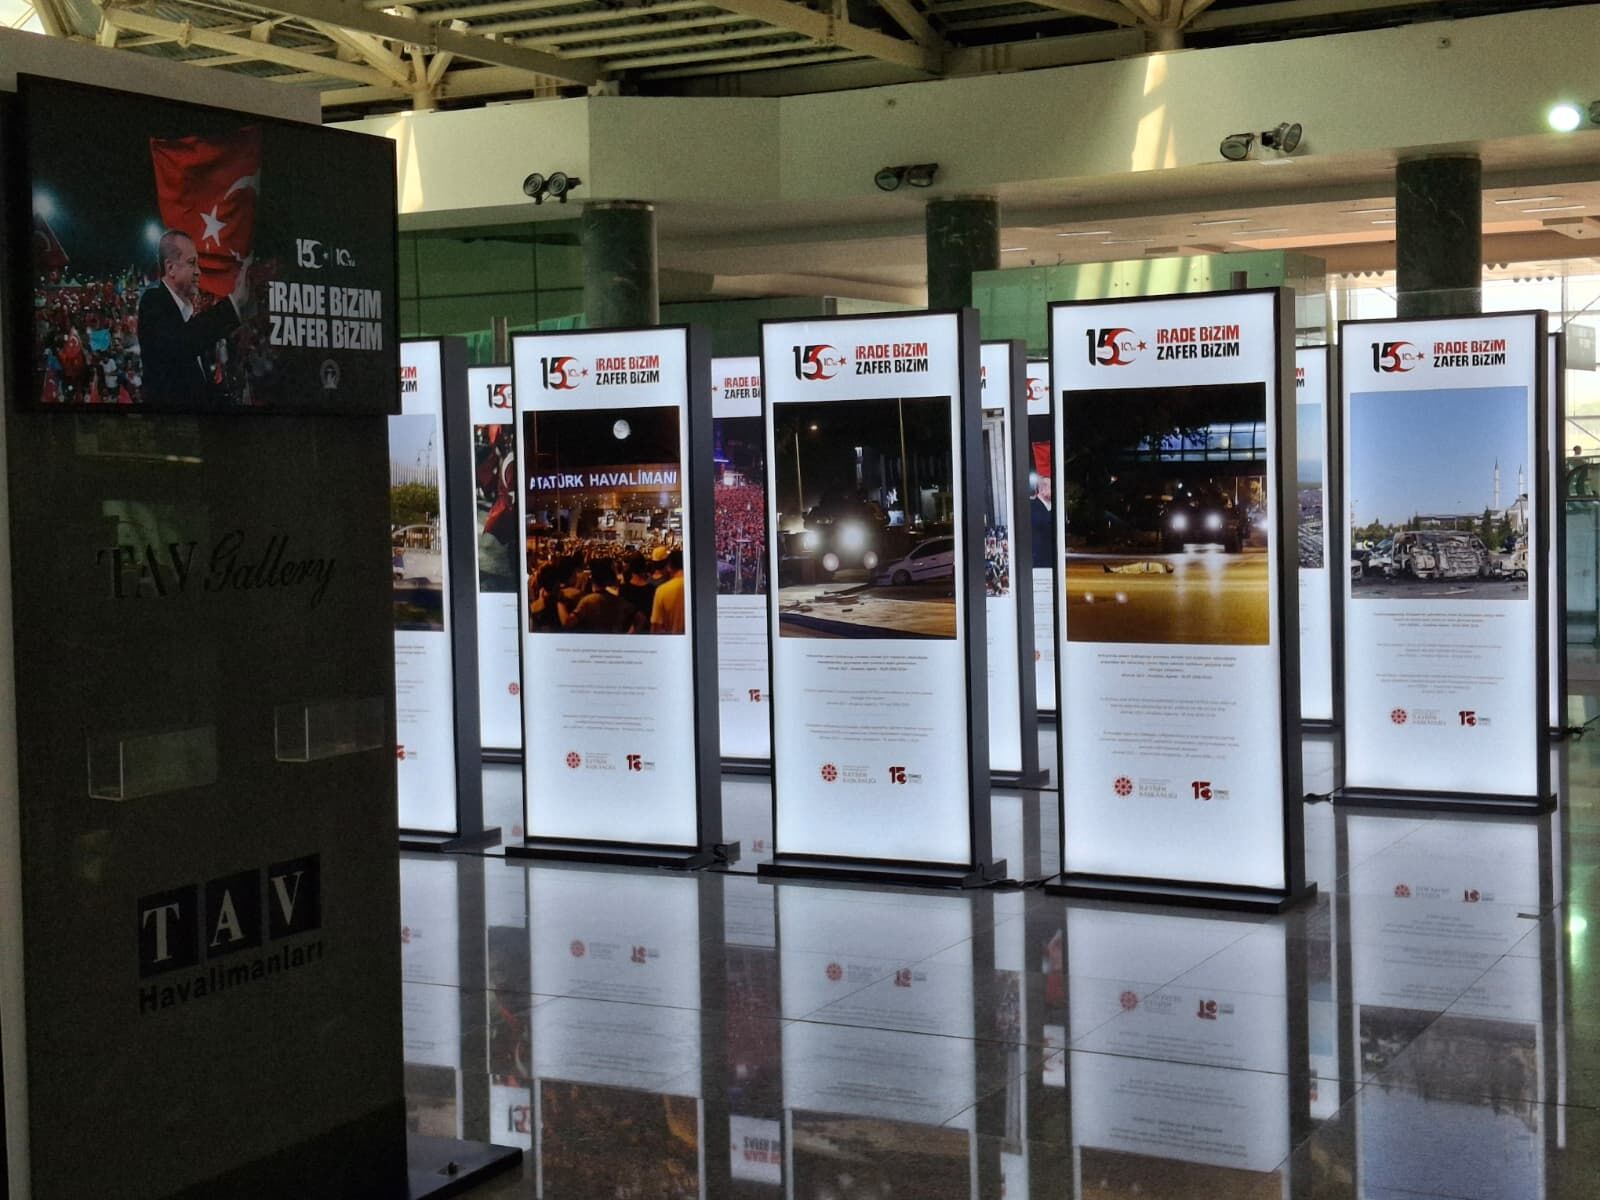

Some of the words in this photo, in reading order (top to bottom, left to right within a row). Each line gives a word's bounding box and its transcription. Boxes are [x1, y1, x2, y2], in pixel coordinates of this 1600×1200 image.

[269, 315, 329, 348] ZAFER
[1156, 344, 1198, 360] ZAFER
[855, 360, 891, 375] ZAFER
[1433, 354, 1469, 368] ZAFER
[596, 372, 627, 386] ZAFER
[724, 388, 750, 400] ZAFER
[96, 541, 198, 599] TAV
[203, 529, 336, 609] Gallery
[142, 870, 305, 963] TAV
